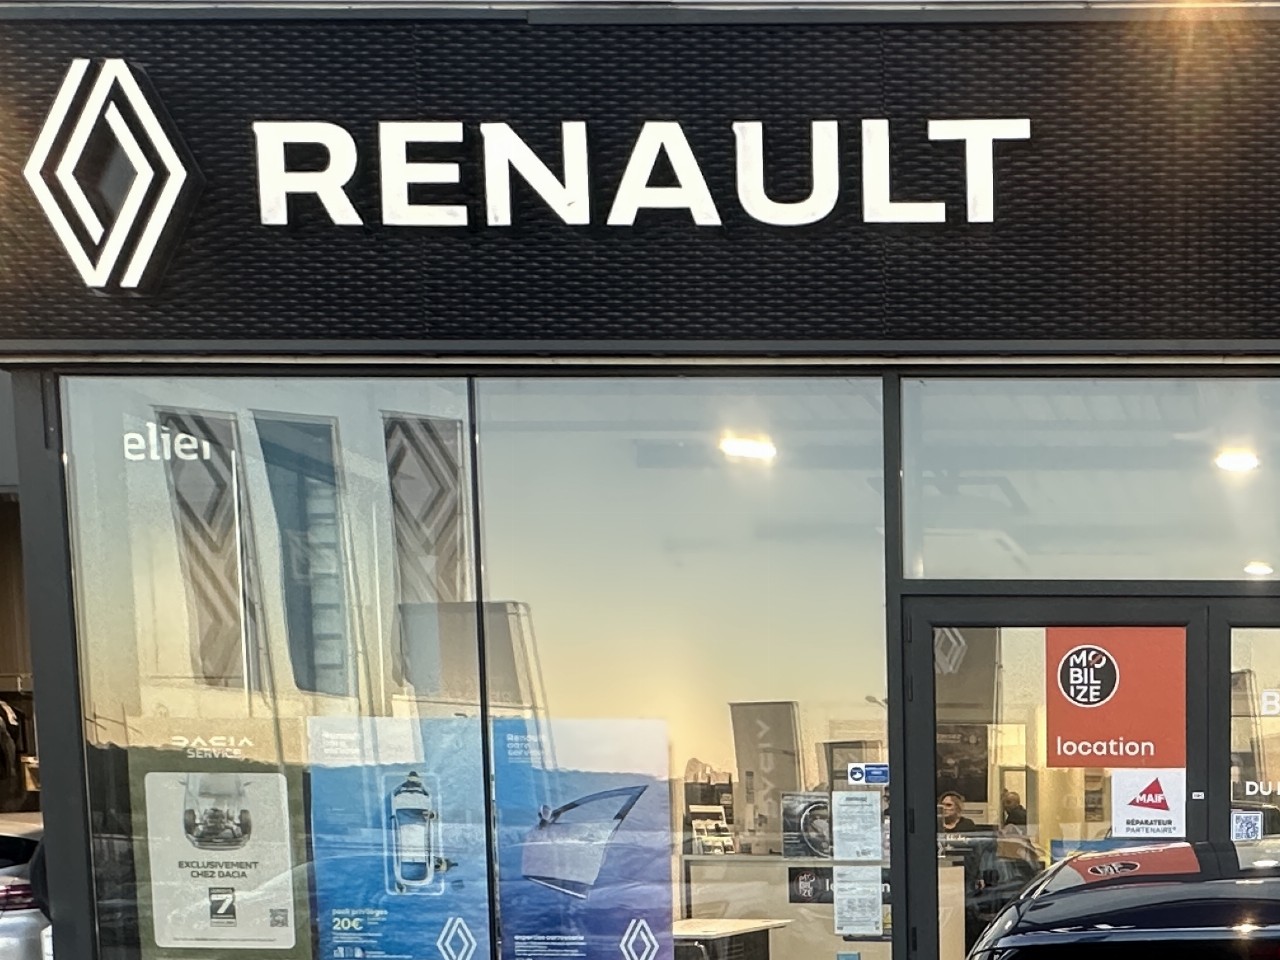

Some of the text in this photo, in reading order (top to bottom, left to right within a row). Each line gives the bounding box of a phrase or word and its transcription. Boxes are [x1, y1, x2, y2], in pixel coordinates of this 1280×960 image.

[253, 118, 1031, 227] RENAULT
[170, 735, 254, 747] DACIA
[1056, 736, 1155, 756] location
[1245, 780, 1273, 797] DU
[1136, 793, 1166, 804] MAIF
[178, 860, 260, 870] EXCLUSIVEMENT
[190, 870, 248, 879] CHEZ DACIA
[332, 917, 364, 931] 20€
